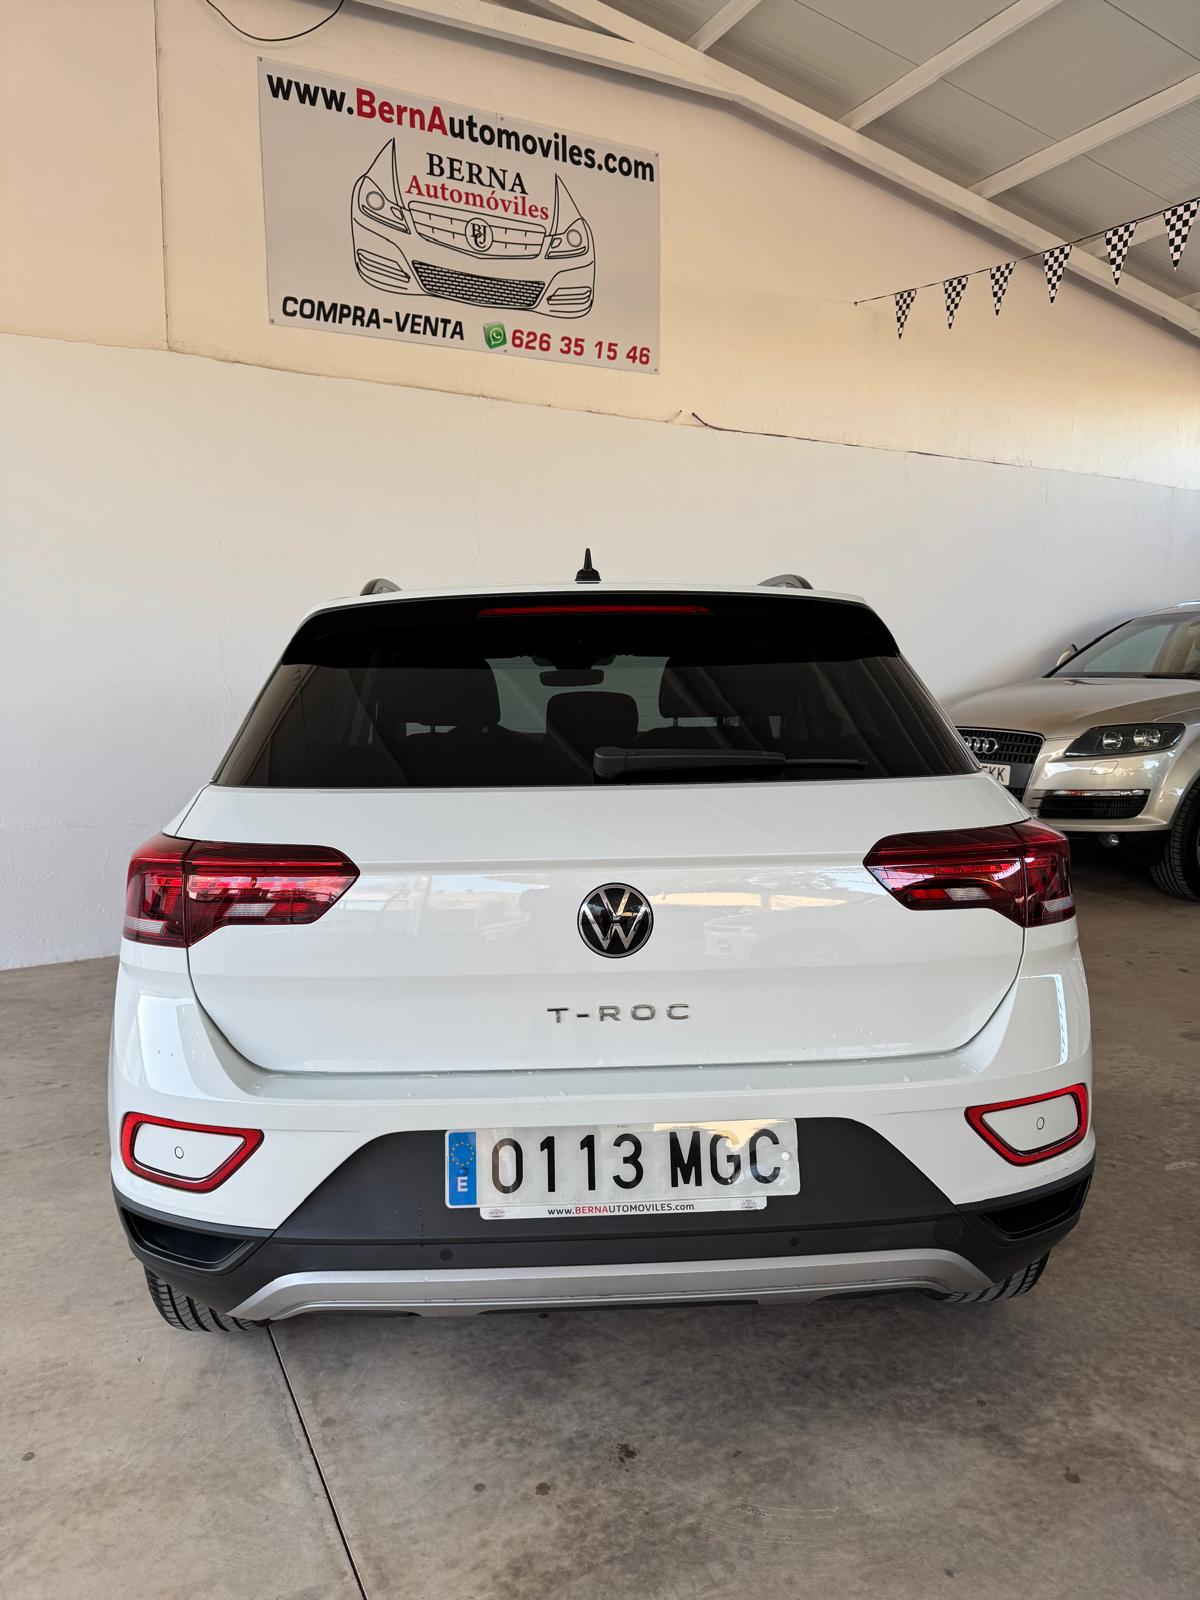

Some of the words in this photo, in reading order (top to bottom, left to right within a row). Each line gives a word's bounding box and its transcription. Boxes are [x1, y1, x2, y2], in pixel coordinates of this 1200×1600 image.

[266, 74, 655, 182] www.BernAutomoviles.com
[425, 152, 529, 195] BERNA
[405, 174, 550, 221] Automóviles
[281, 295, 465, 341] COMPRA-VENTA
[511, 329, 552, 352] 626
[559, 336, 585, 357] 35
[594, 340, 618, 361] 15
[626, 345, 651, 365] 46
[581, 886, 649, 951] VW
[547, 1003, 690, 1023] T-ROC
[491, 1133, 644, 1194] 0113
[669, 1128, 781, 1188] MGC
[457, 1176, 468, 1192] E
[547, 1202, 695, 1216] www.BERNAUTOMOVILES.com
